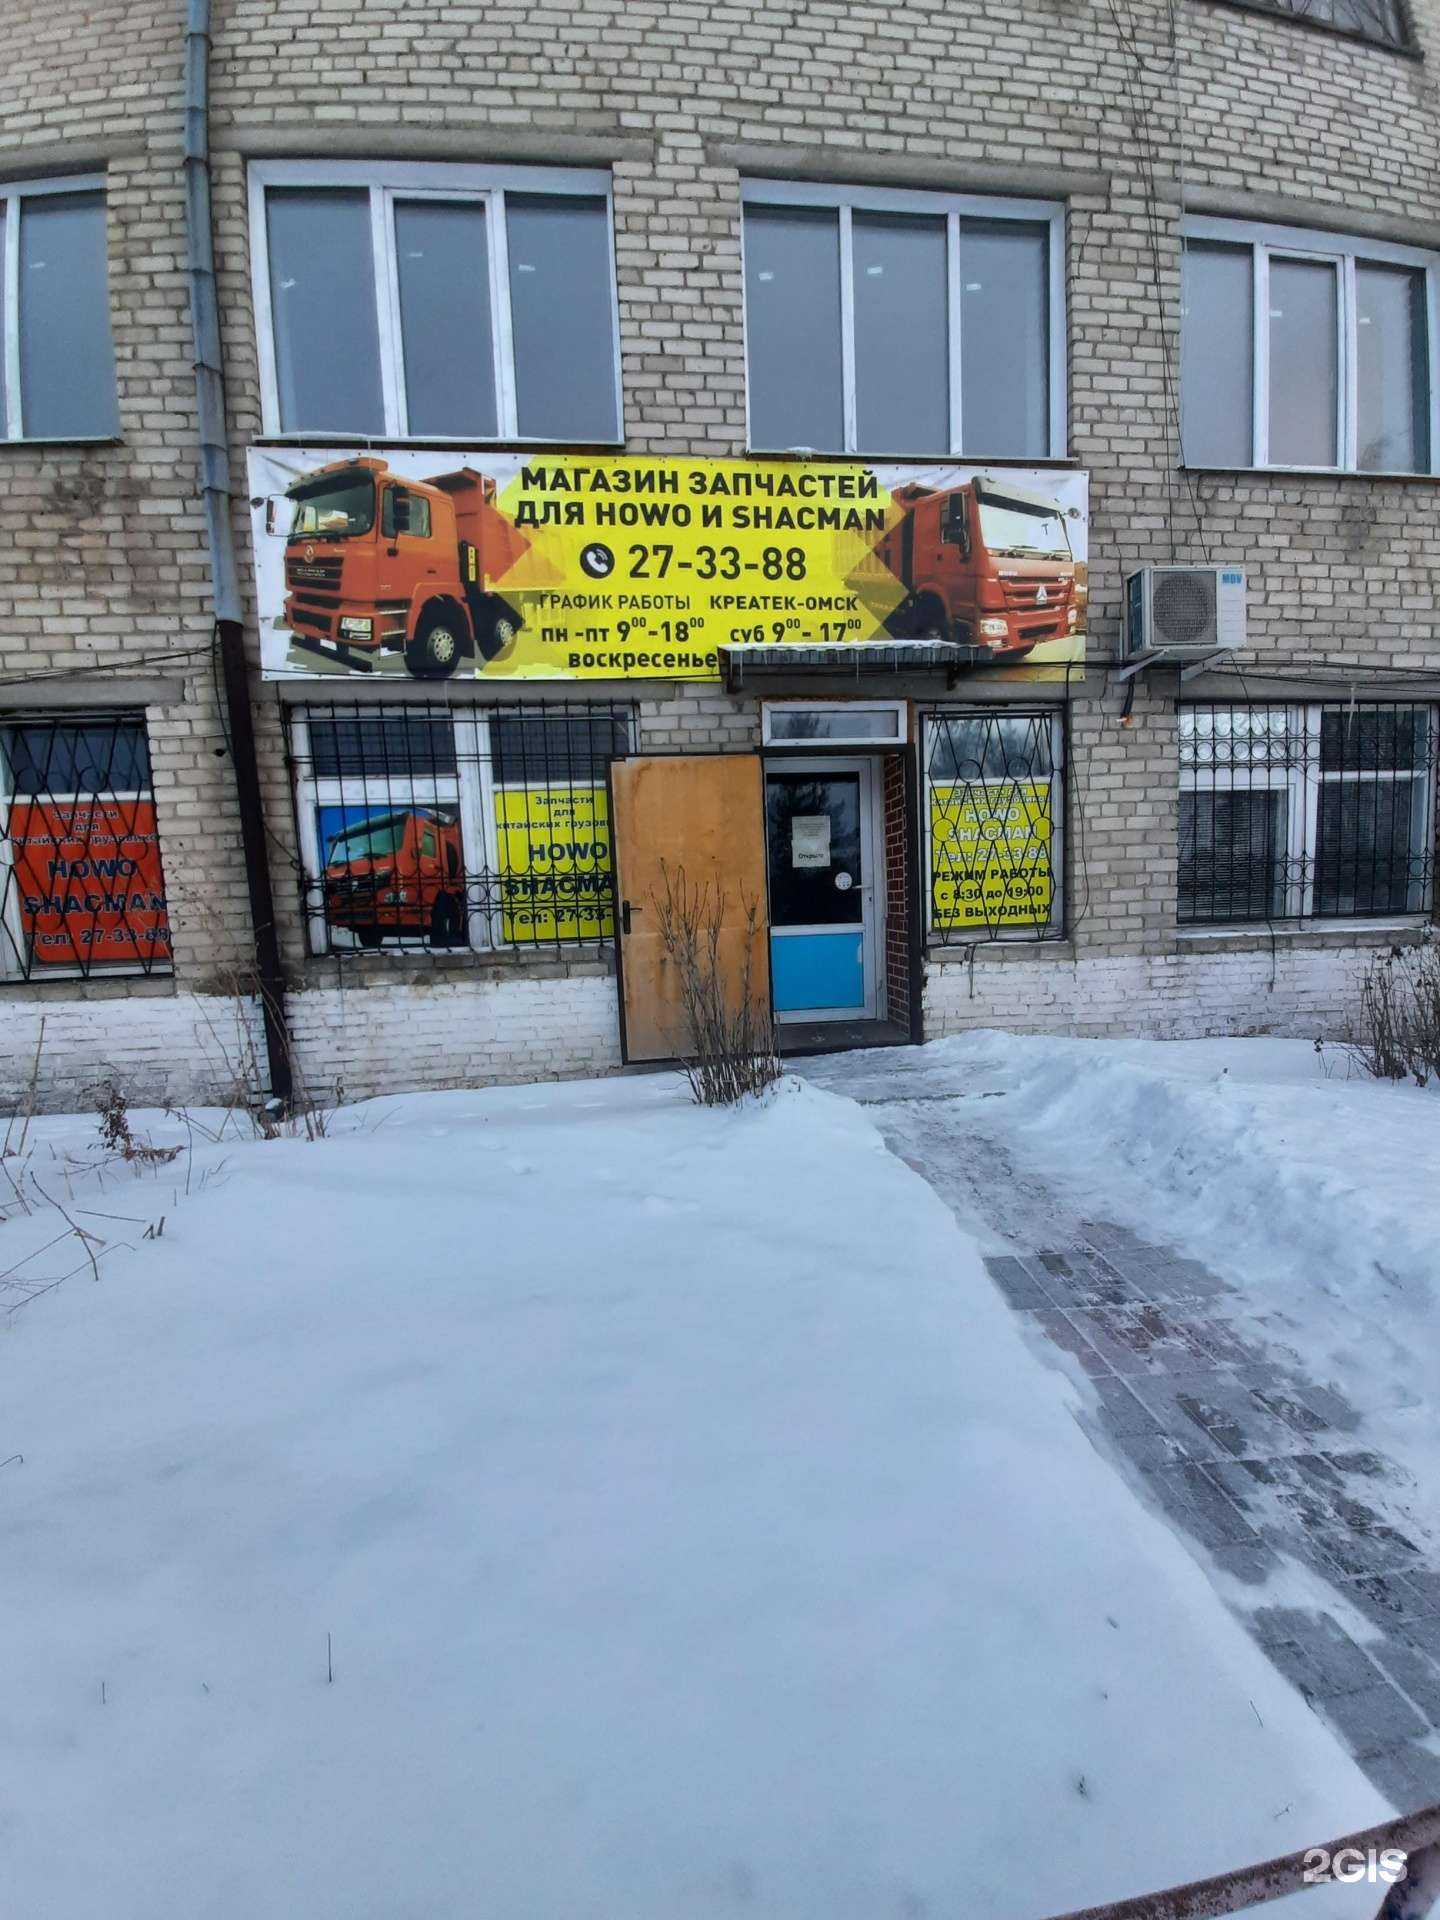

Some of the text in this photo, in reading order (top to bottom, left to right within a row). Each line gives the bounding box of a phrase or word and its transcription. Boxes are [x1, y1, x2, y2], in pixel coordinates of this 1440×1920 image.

[521, 467, 878, 499] МАГАЗИН ЗАПЧАСТЕЙ
[514, 501, 885, 531] ДЛЯ HOWO И SHACMAN
[629, 544, 806, 581] 27-33-88
[540, 594, 690, 610] ГРАФИК РАБОТЫ
[710, 595, 857, 611] КРЕАТЕК-ОМСК
[542, 627, 568, 642] пн
[730, 622, 765, 643] суб
[569, 652, 717, 670] воскресенье
[536, 796, 593, 805] Запчасти
[965, 808, 1020, 822] HOWO
[948, 826, 1037, 842] SHACMAN
[529, 842, 607, 861] HOWO
[977, 847, 1047, 861] 27-33-88
[48, 859, 137, 879] HOWO
[934, 868, 1050, 881] РЕЖИМ РАБОТЫ
[505, 873, 613, 895] SHACMA
[940, 886, 1044, 900] с 8:30 до 19:00
[24, 893, 167, 915] SHACMAN
[934, 904, 1050, 919] БЕЗ ВЫХОДНЫХ
